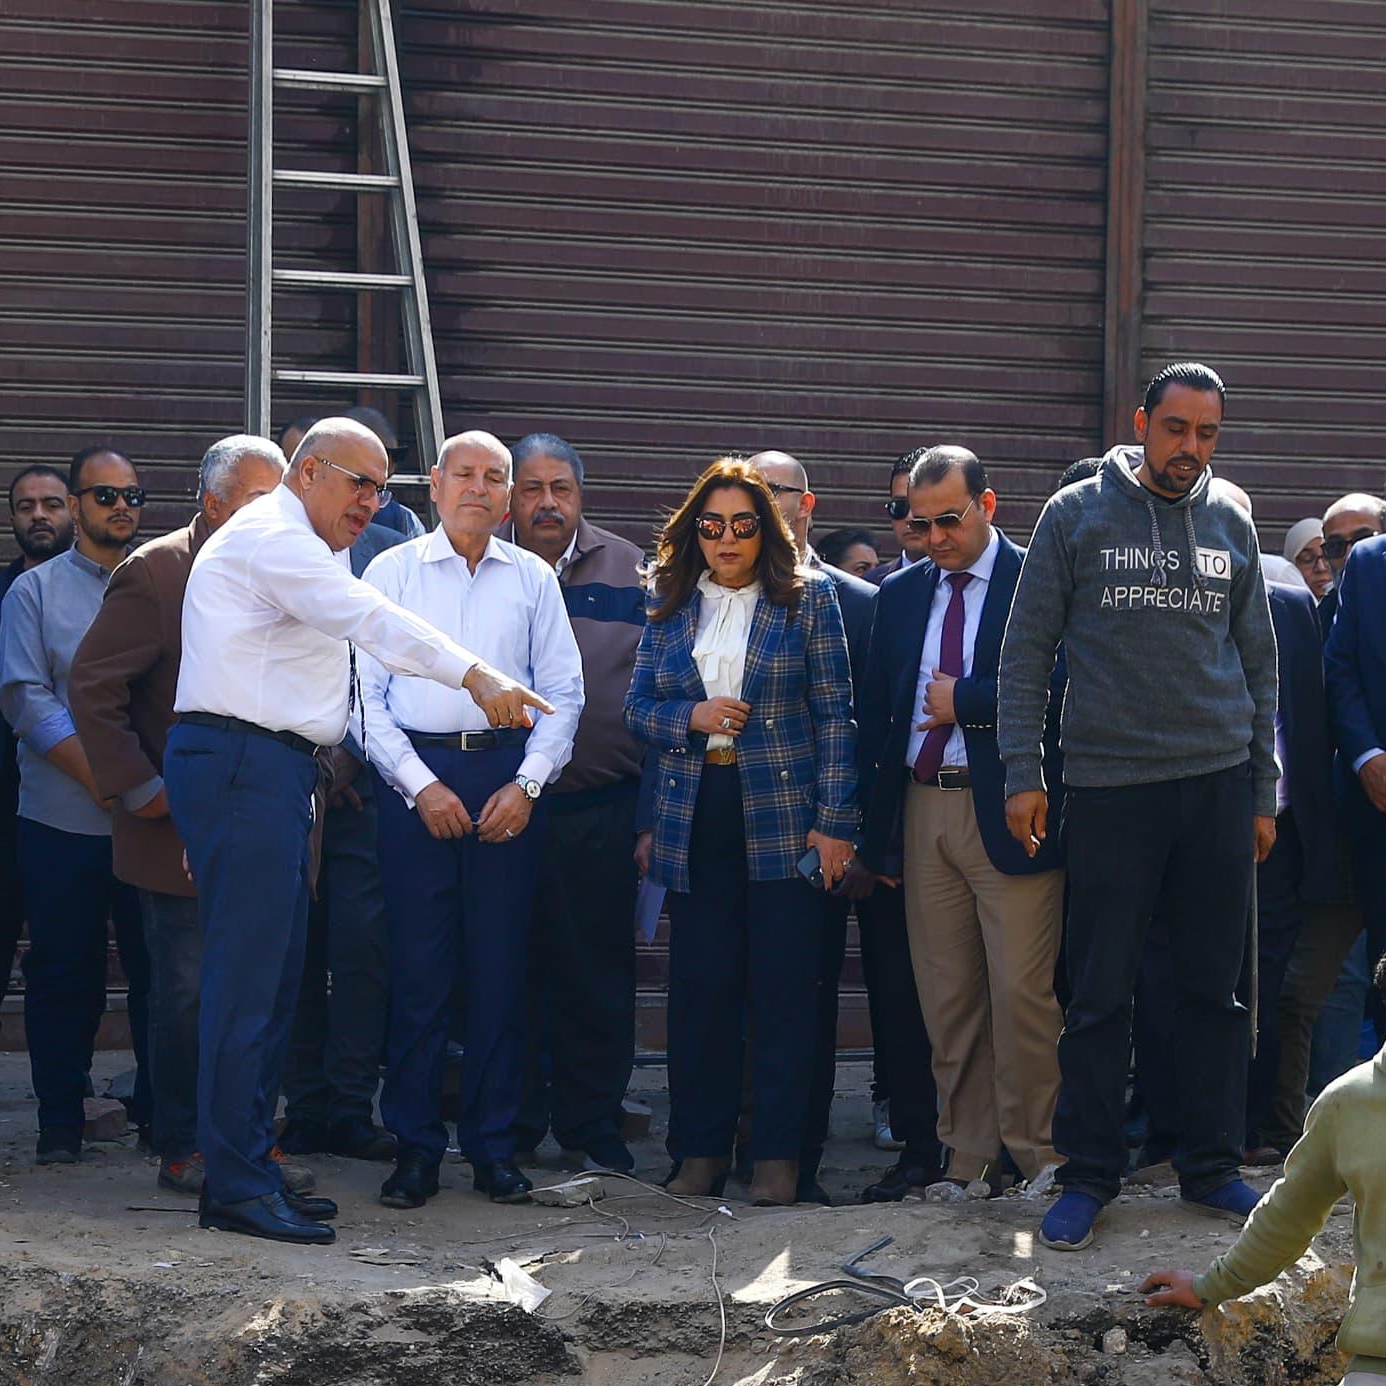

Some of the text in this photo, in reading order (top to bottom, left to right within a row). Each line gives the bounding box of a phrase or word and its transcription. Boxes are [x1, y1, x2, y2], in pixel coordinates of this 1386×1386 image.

[1099, 547, 1227, 575] THINGS TO
[1100, 586, 1225, 613] APPRECIATE
